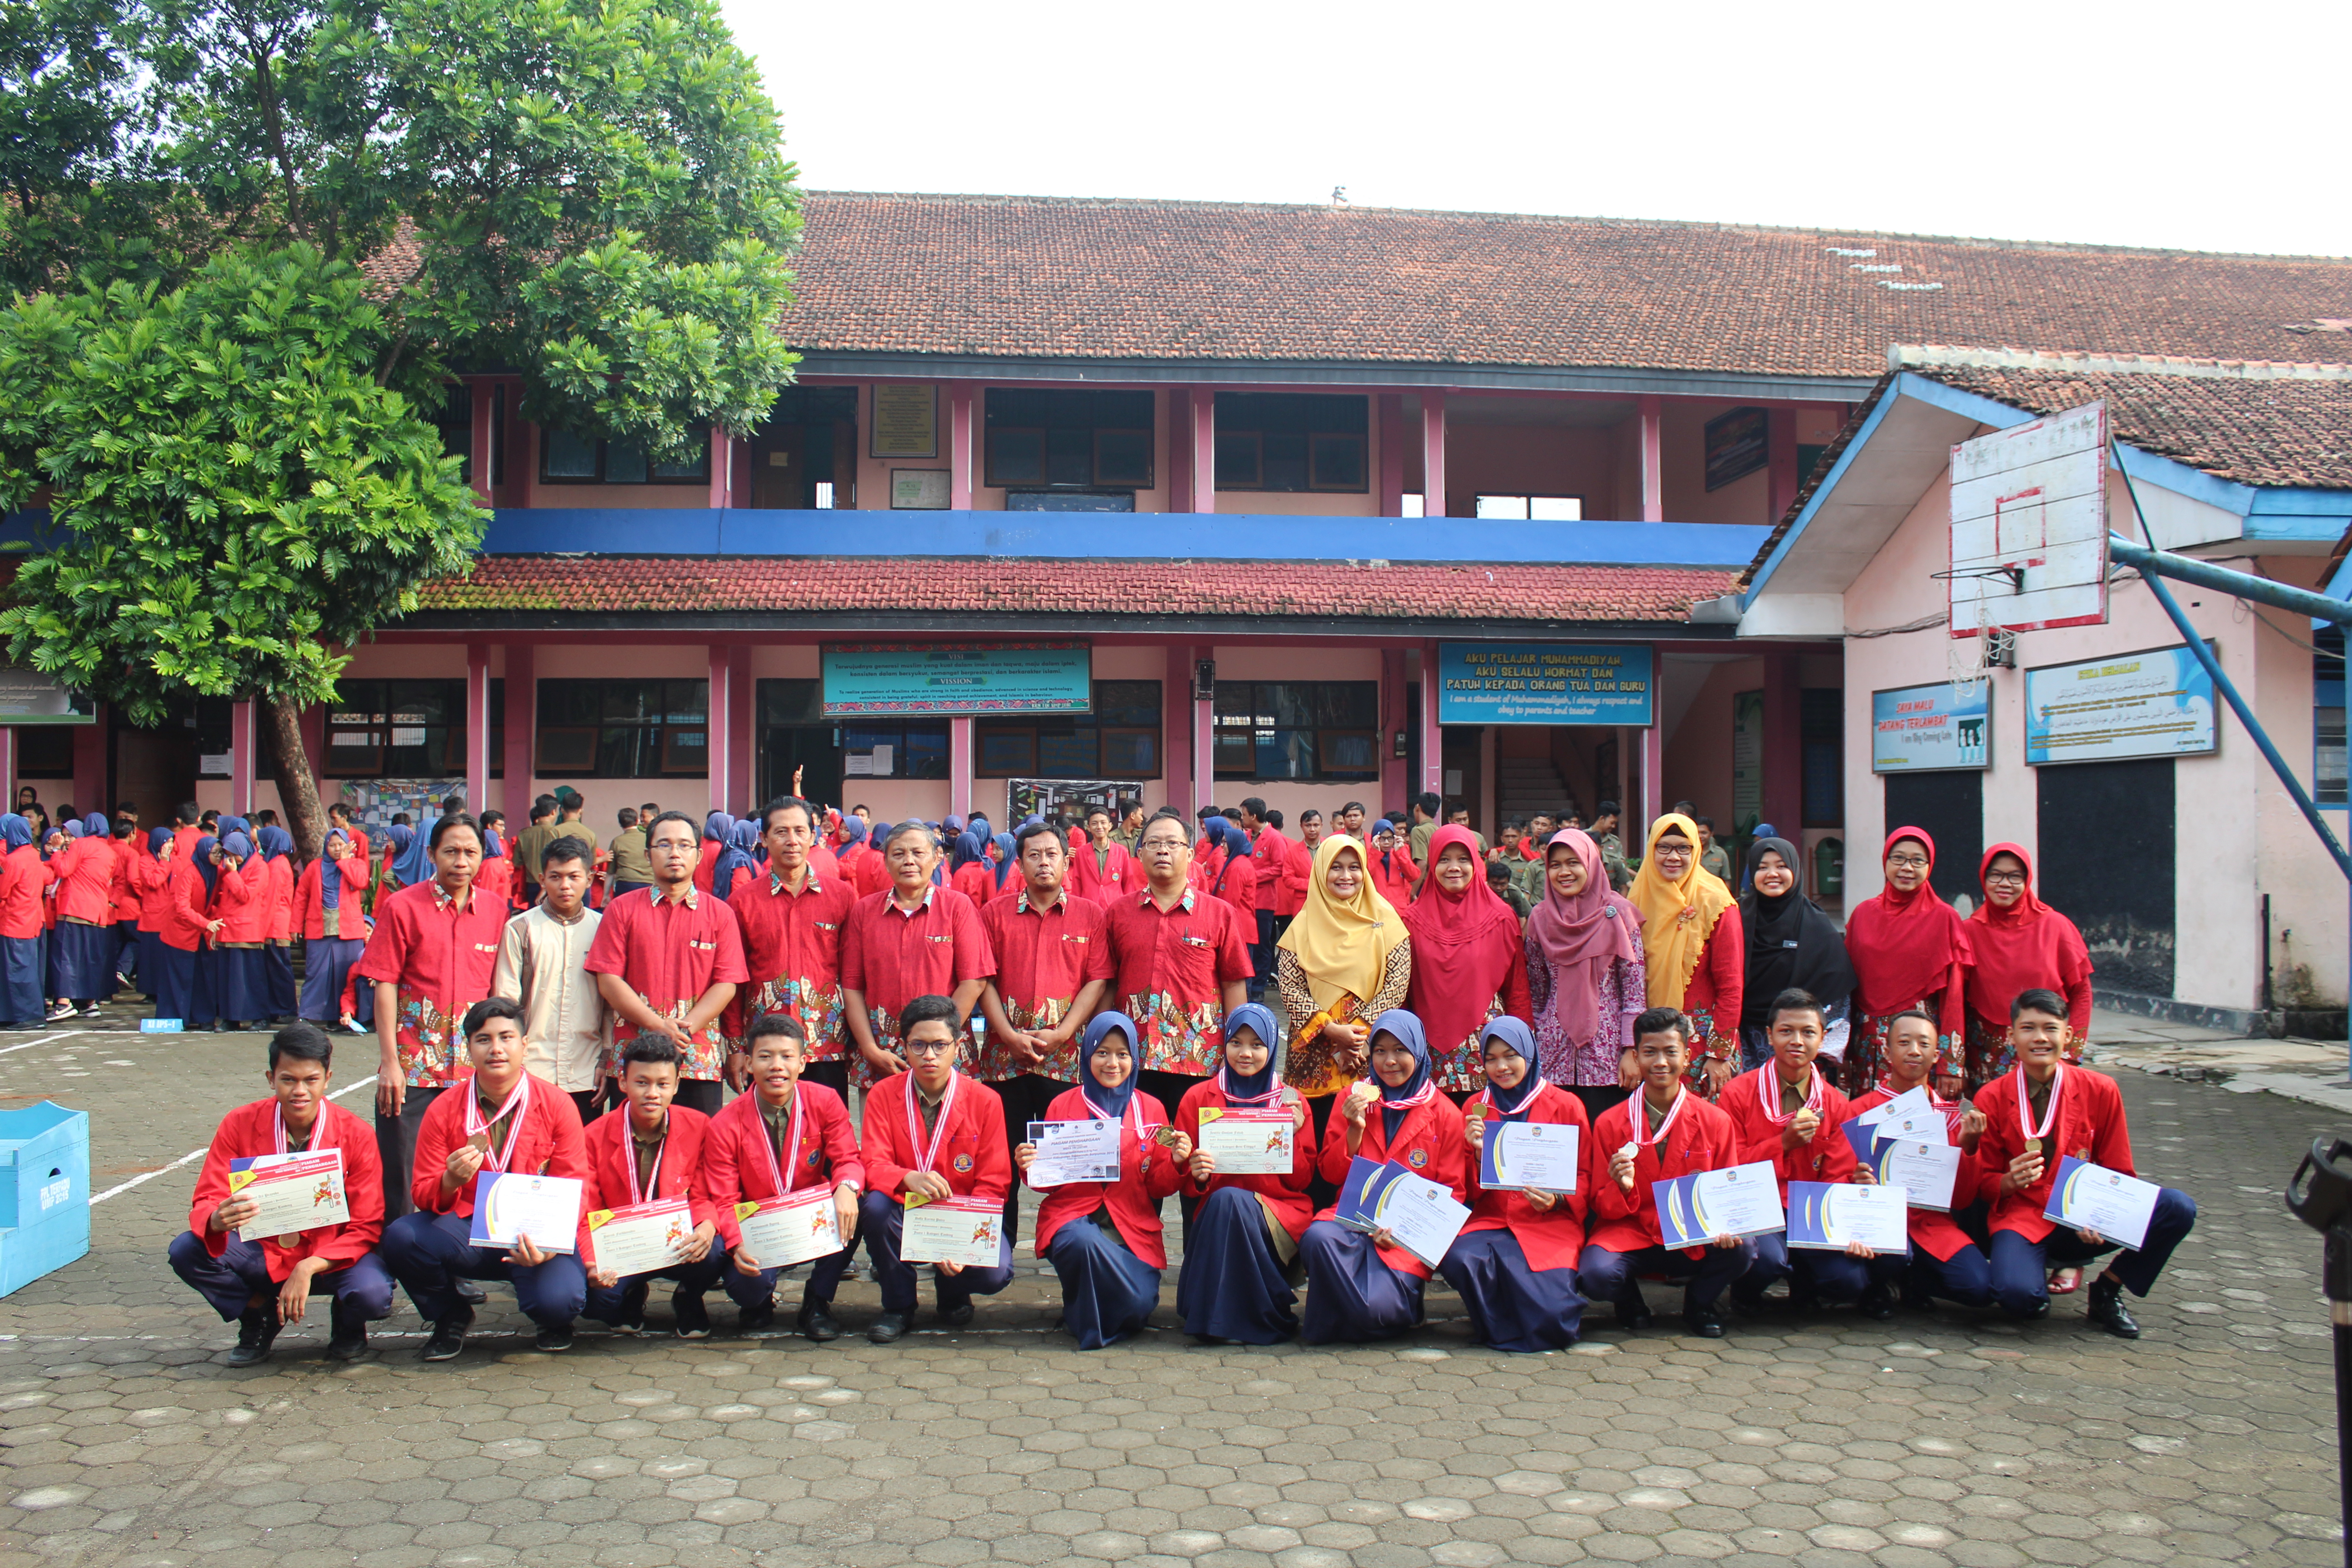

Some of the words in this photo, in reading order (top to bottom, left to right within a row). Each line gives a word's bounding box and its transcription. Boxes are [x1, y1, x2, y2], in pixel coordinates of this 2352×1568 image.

[1465, 653, 1486, 663] AKU
[1490, 654, 1536, 664] PELAJAR
[1541, 655, 1622, 666] MUHAMMADIYAH,
[1475, 667, 1496, 676] AKU
[1501, 667, 1540, 677] SELALU
[1545, 667, 1588, 678] HORMAT
[1592, 668, 1613, 678] DAN
[1446, 680, 1480, 690] PATUH
[1485, 680, 1525, 691] KEPADA
[1530, 680, 1565, 691] ORANG
[1571, 681, 1590, 691] TUA
[1594, 681, 1616, 692] DAN
[1619, 681, 1646, 692] GURU
[1473, 695, 1501, 704] student
[1502, 694, 1510, 704] of
[1628, 696, 1643, 705] and
[1524, 706, 1553, 716] parents
[1554, 706, 1568, 714] and
[1896, 702, 1912, 714] SAYA
[1914, 699, 1935, 711] MALU
[1878, 719, 1905, 732] DATANG
[1907, 714, 1950, 730] TERLAMBAT
[147, 1019, 155, 1028] XI
[156, 1019, 175, 1028] IPS-1
[302, 1160, 337, 1171] PENGHARGAAN
[40, 1186, 49, 1200] PPL
[50, 1176, 70, 1196] TERPADU
[799, 1188, 815, 1196] PIAGAM
[42, 1196, 54, 1210] UMP
[55, 1189, 69, 1204] 2015
[799, 1189, 831, 1200] PENGHARGAAN
[655, 1200, 688, 1210] PENGHARGAAN
